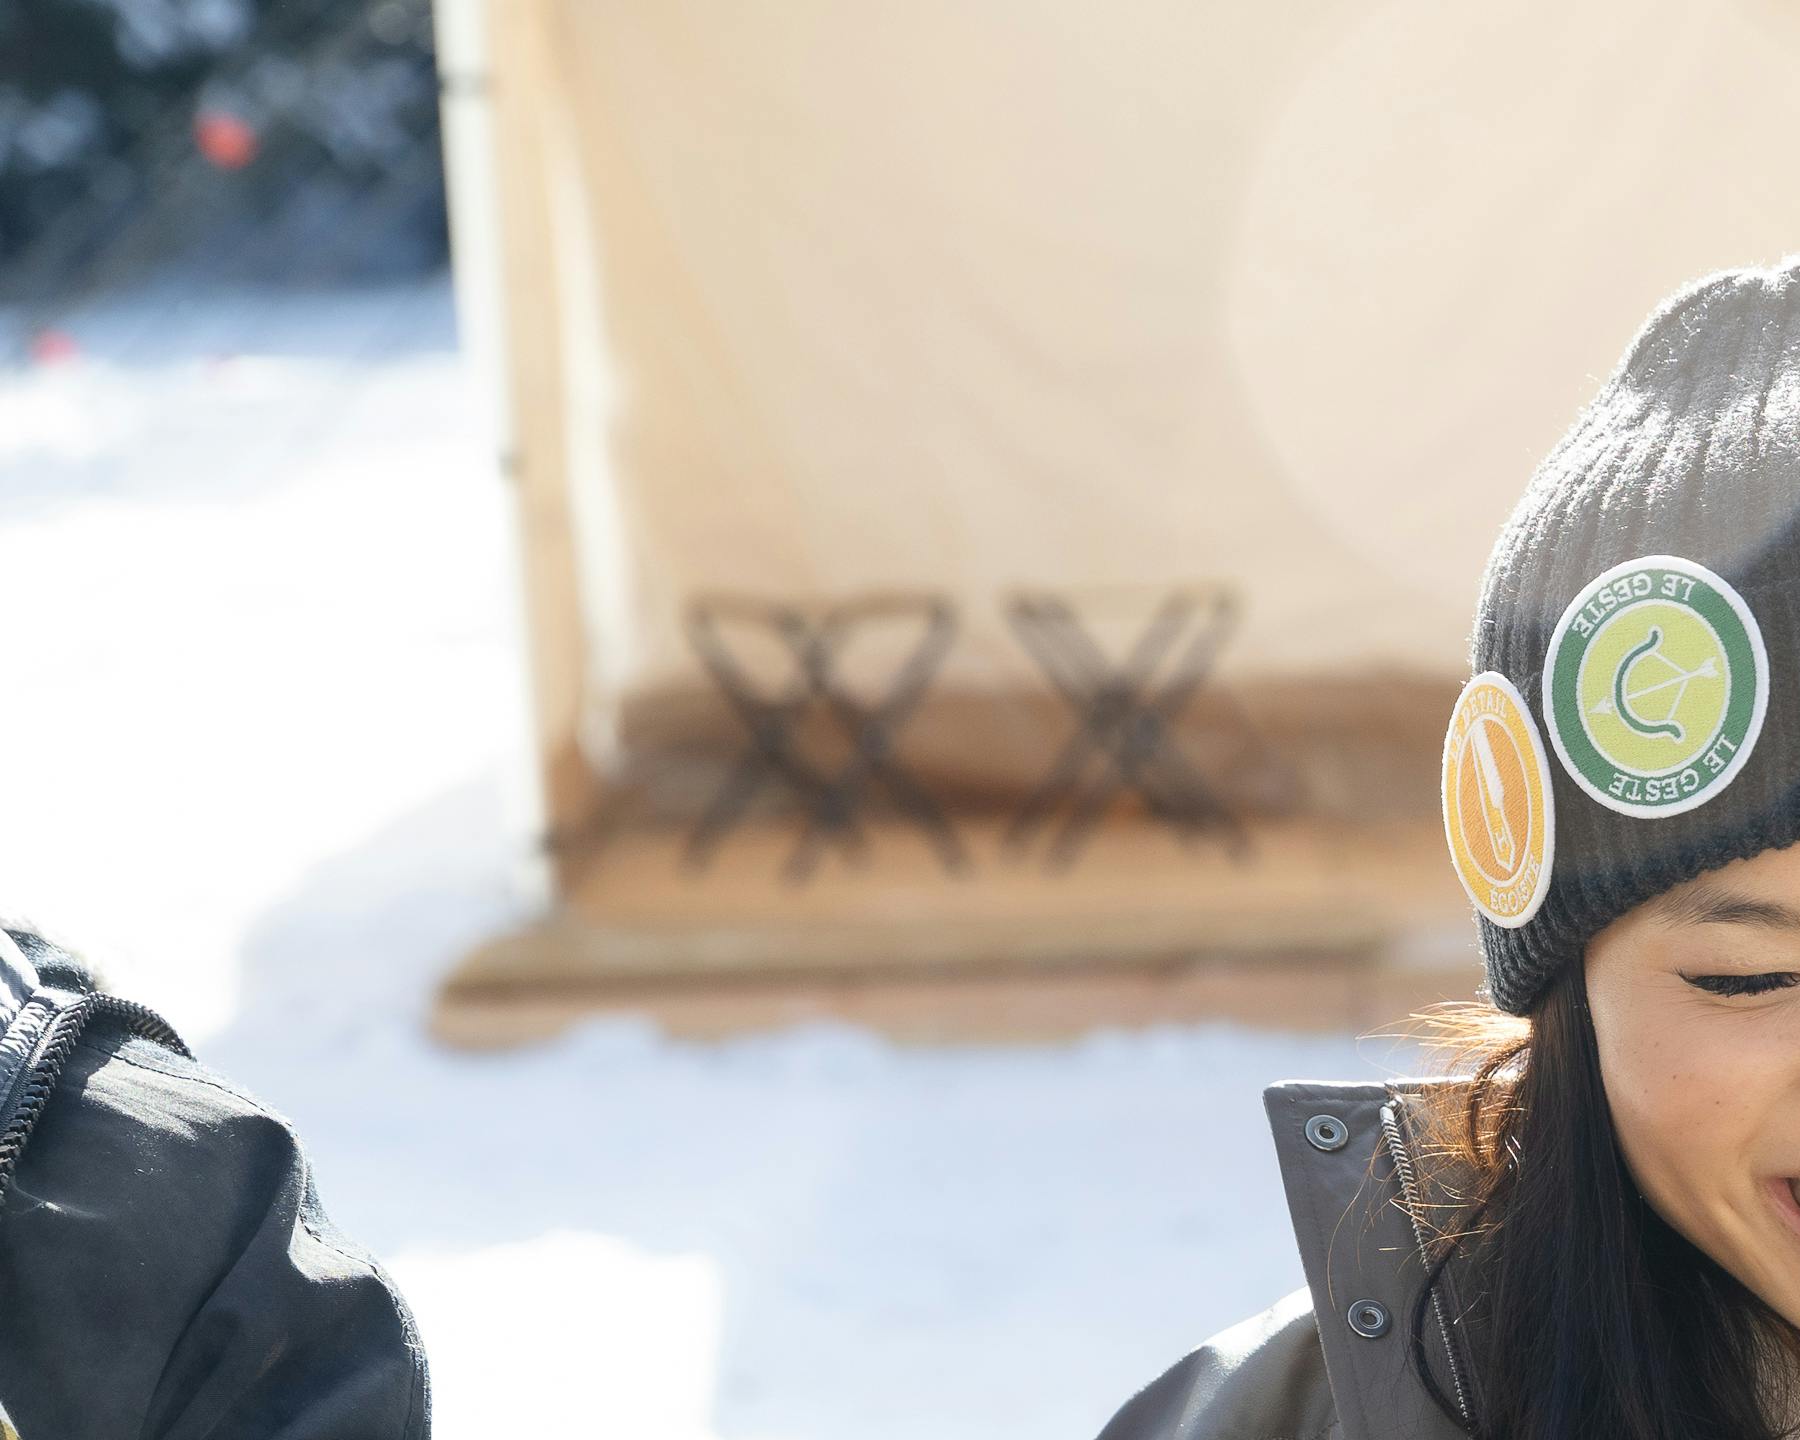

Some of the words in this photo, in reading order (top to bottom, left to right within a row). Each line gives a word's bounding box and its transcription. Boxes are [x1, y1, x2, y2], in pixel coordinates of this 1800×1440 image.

[1661, 573, 1696, 602] LE
[1573, 574, 1653, 638] GESTE
[1703, 733, 1737, 775] LE
[1609, 772, 1700, 802] GESTE
